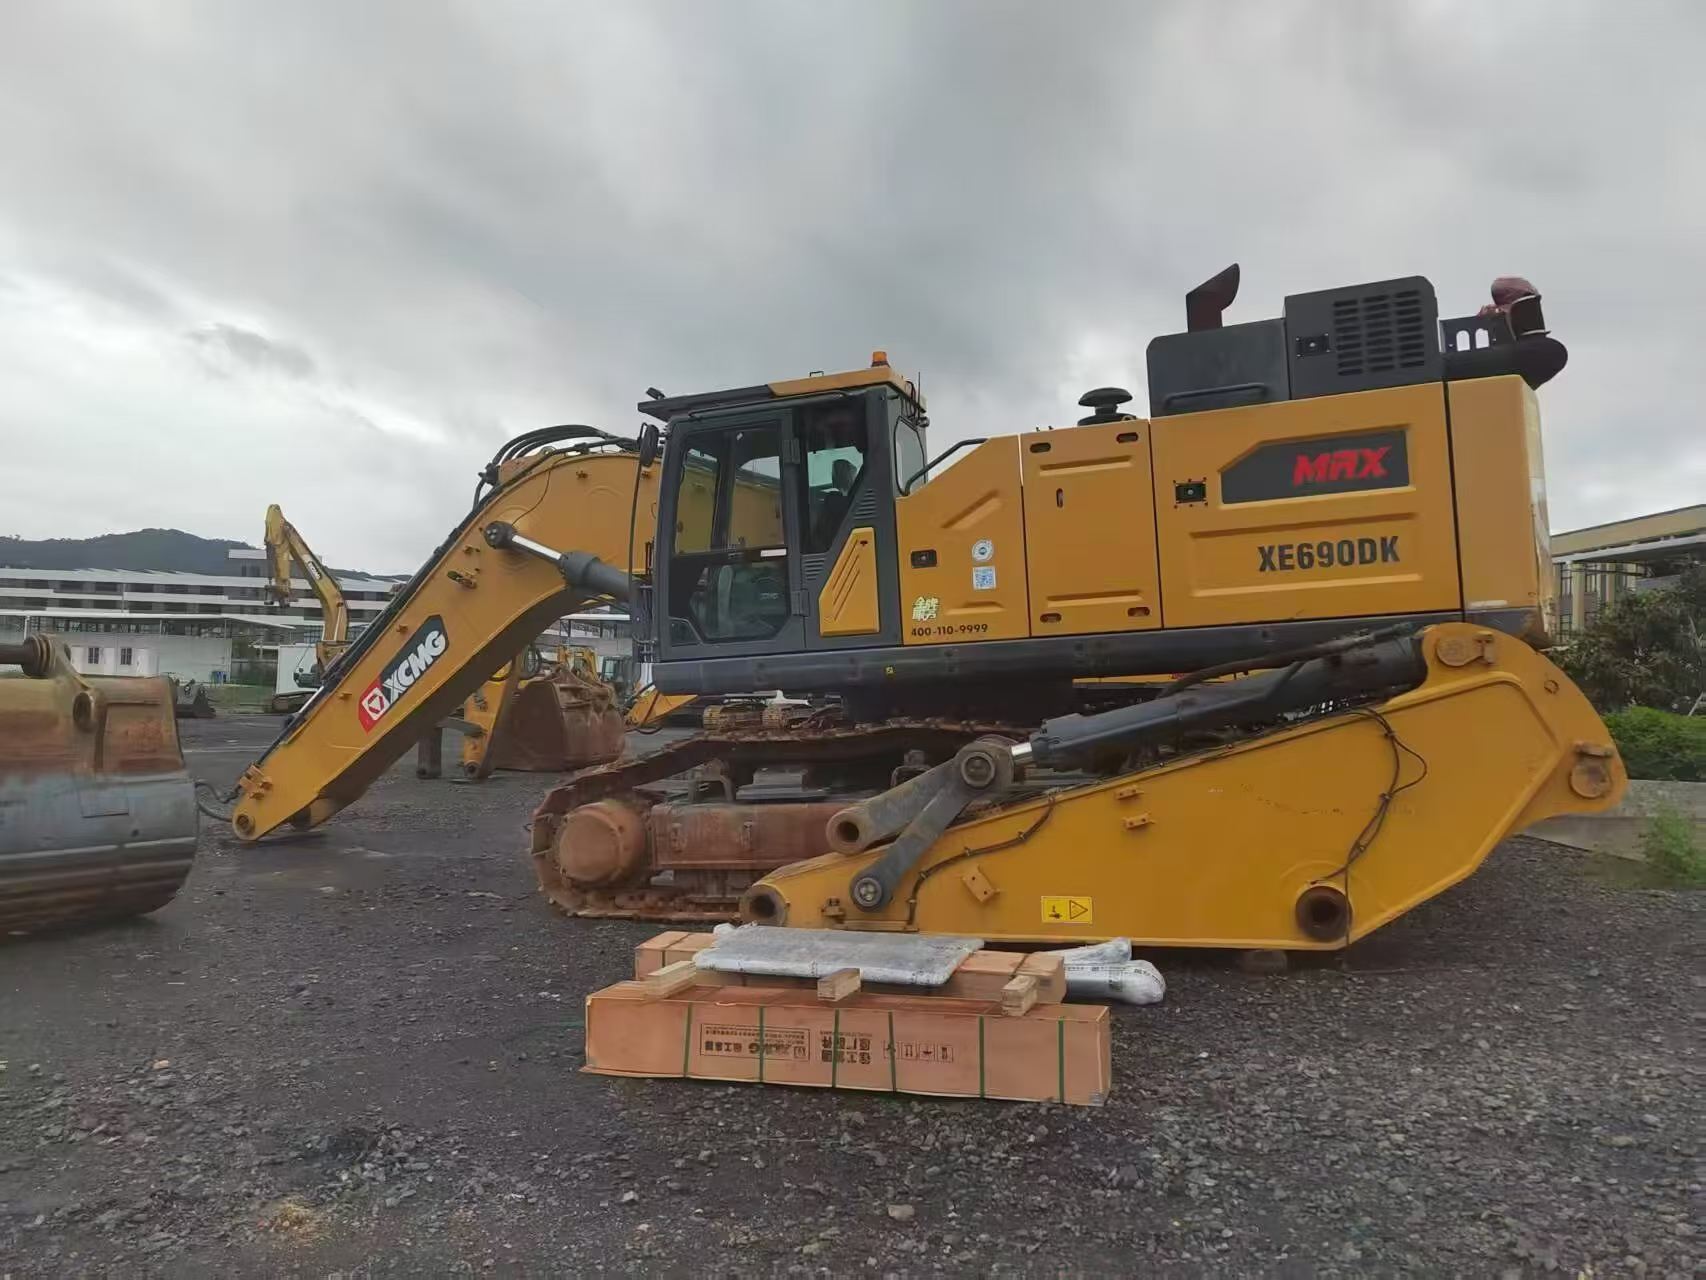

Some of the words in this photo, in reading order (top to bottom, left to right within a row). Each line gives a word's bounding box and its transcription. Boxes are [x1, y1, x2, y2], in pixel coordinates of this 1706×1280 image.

[1293, 444, 1392, 487] MAX
[1258, 536, 1400, 572] XE690DK
[911, 624, 988, 636] 400-110-9999
[382, 630, 446, 704] XCMG
